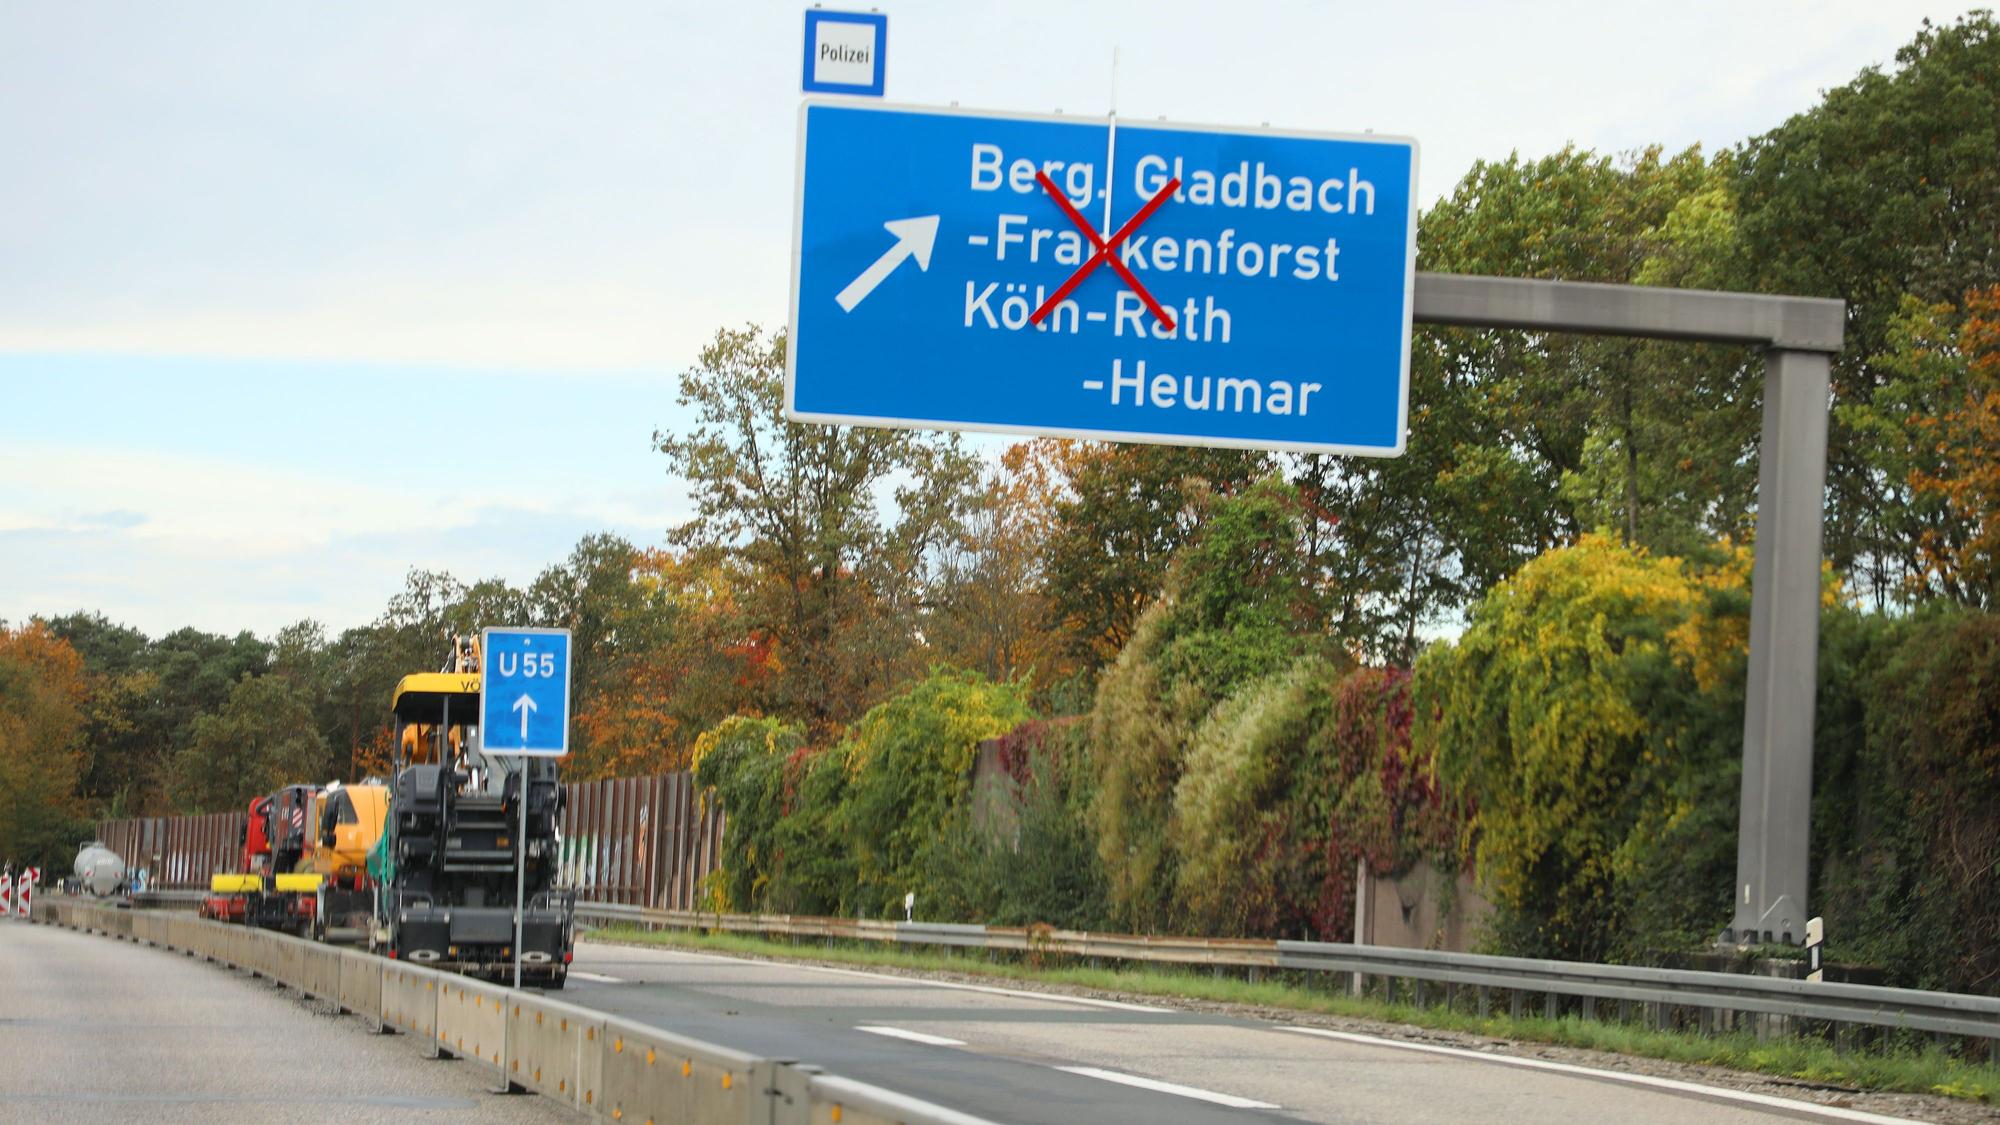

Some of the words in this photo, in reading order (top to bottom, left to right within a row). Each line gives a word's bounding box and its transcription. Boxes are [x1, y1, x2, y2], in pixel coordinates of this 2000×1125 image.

[821, 43, 870, 64] Polizei
[970, 143, 1107, 210] Berg.
[1134, 154, 1376, 216] Gladbach
[964, 280, 1232, 343] Köln-Rath
[1082, 358, 1323, 418] -Heumar
[499, 652, 518, 678] U
[523, 652, 555, 679] 55
